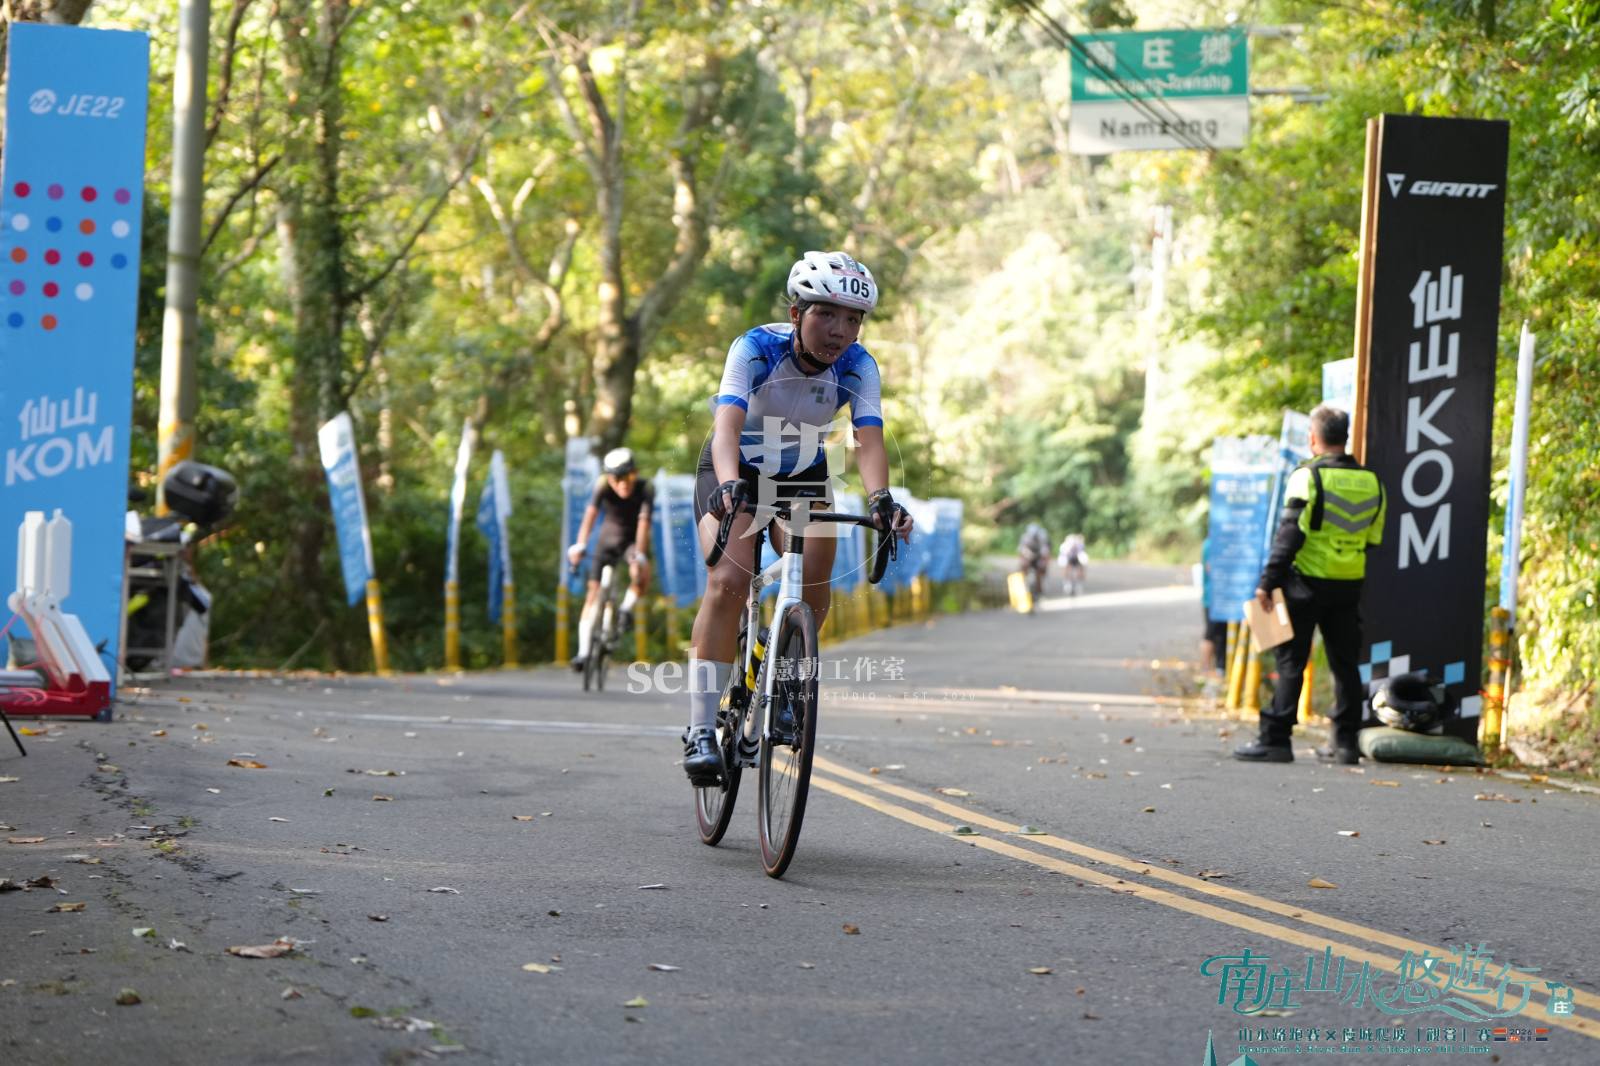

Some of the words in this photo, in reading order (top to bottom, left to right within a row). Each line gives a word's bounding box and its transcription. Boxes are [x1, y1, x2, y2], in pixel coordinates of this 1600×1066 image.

[57, 94, 125, 119] JE22
[1409, 180, 1498, 198] GIANT
[838, 276, 870, 298] 105
[18, 386, 98, 441] 仙山
[4, 426, 115, 486] KOM
